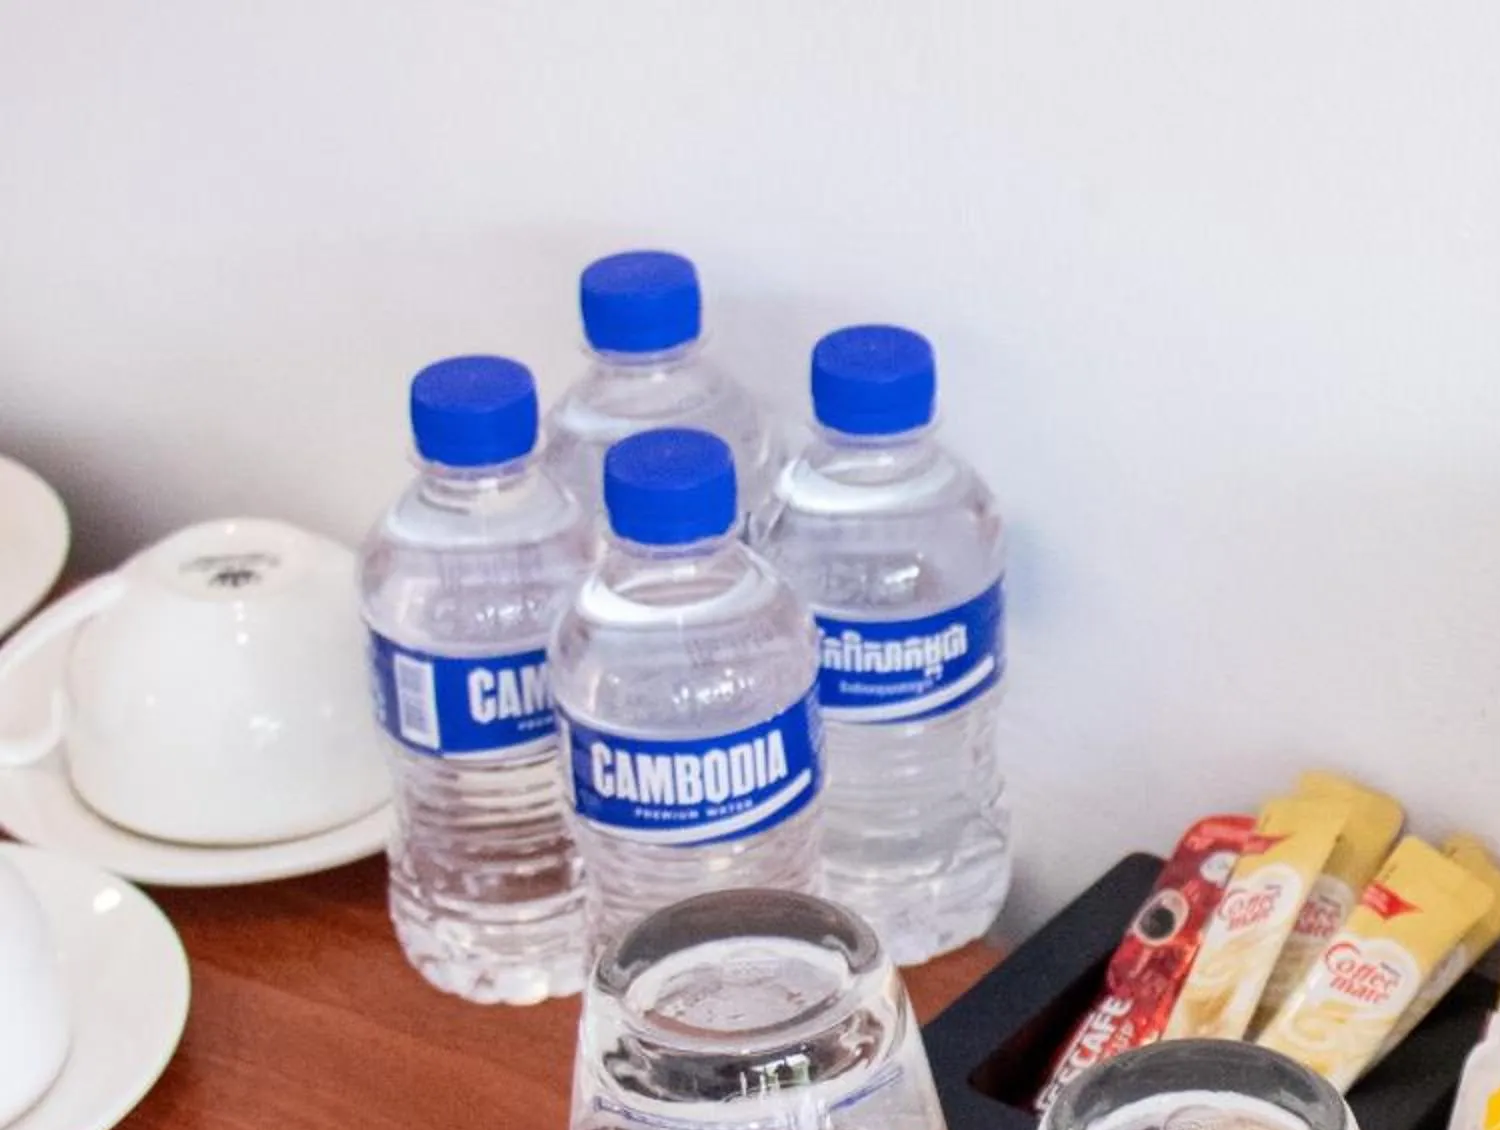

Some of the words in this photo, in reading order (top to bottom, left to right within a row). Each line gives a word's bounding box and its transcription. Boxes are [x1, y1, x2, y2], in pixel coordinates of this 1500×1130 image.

[467, 662, 554, 725] CAM
[591, 729, 788, 806] CAMBODIA
[634, 806, 700, 820] PREMIUM
[705, 799, 753, 817] WATER
